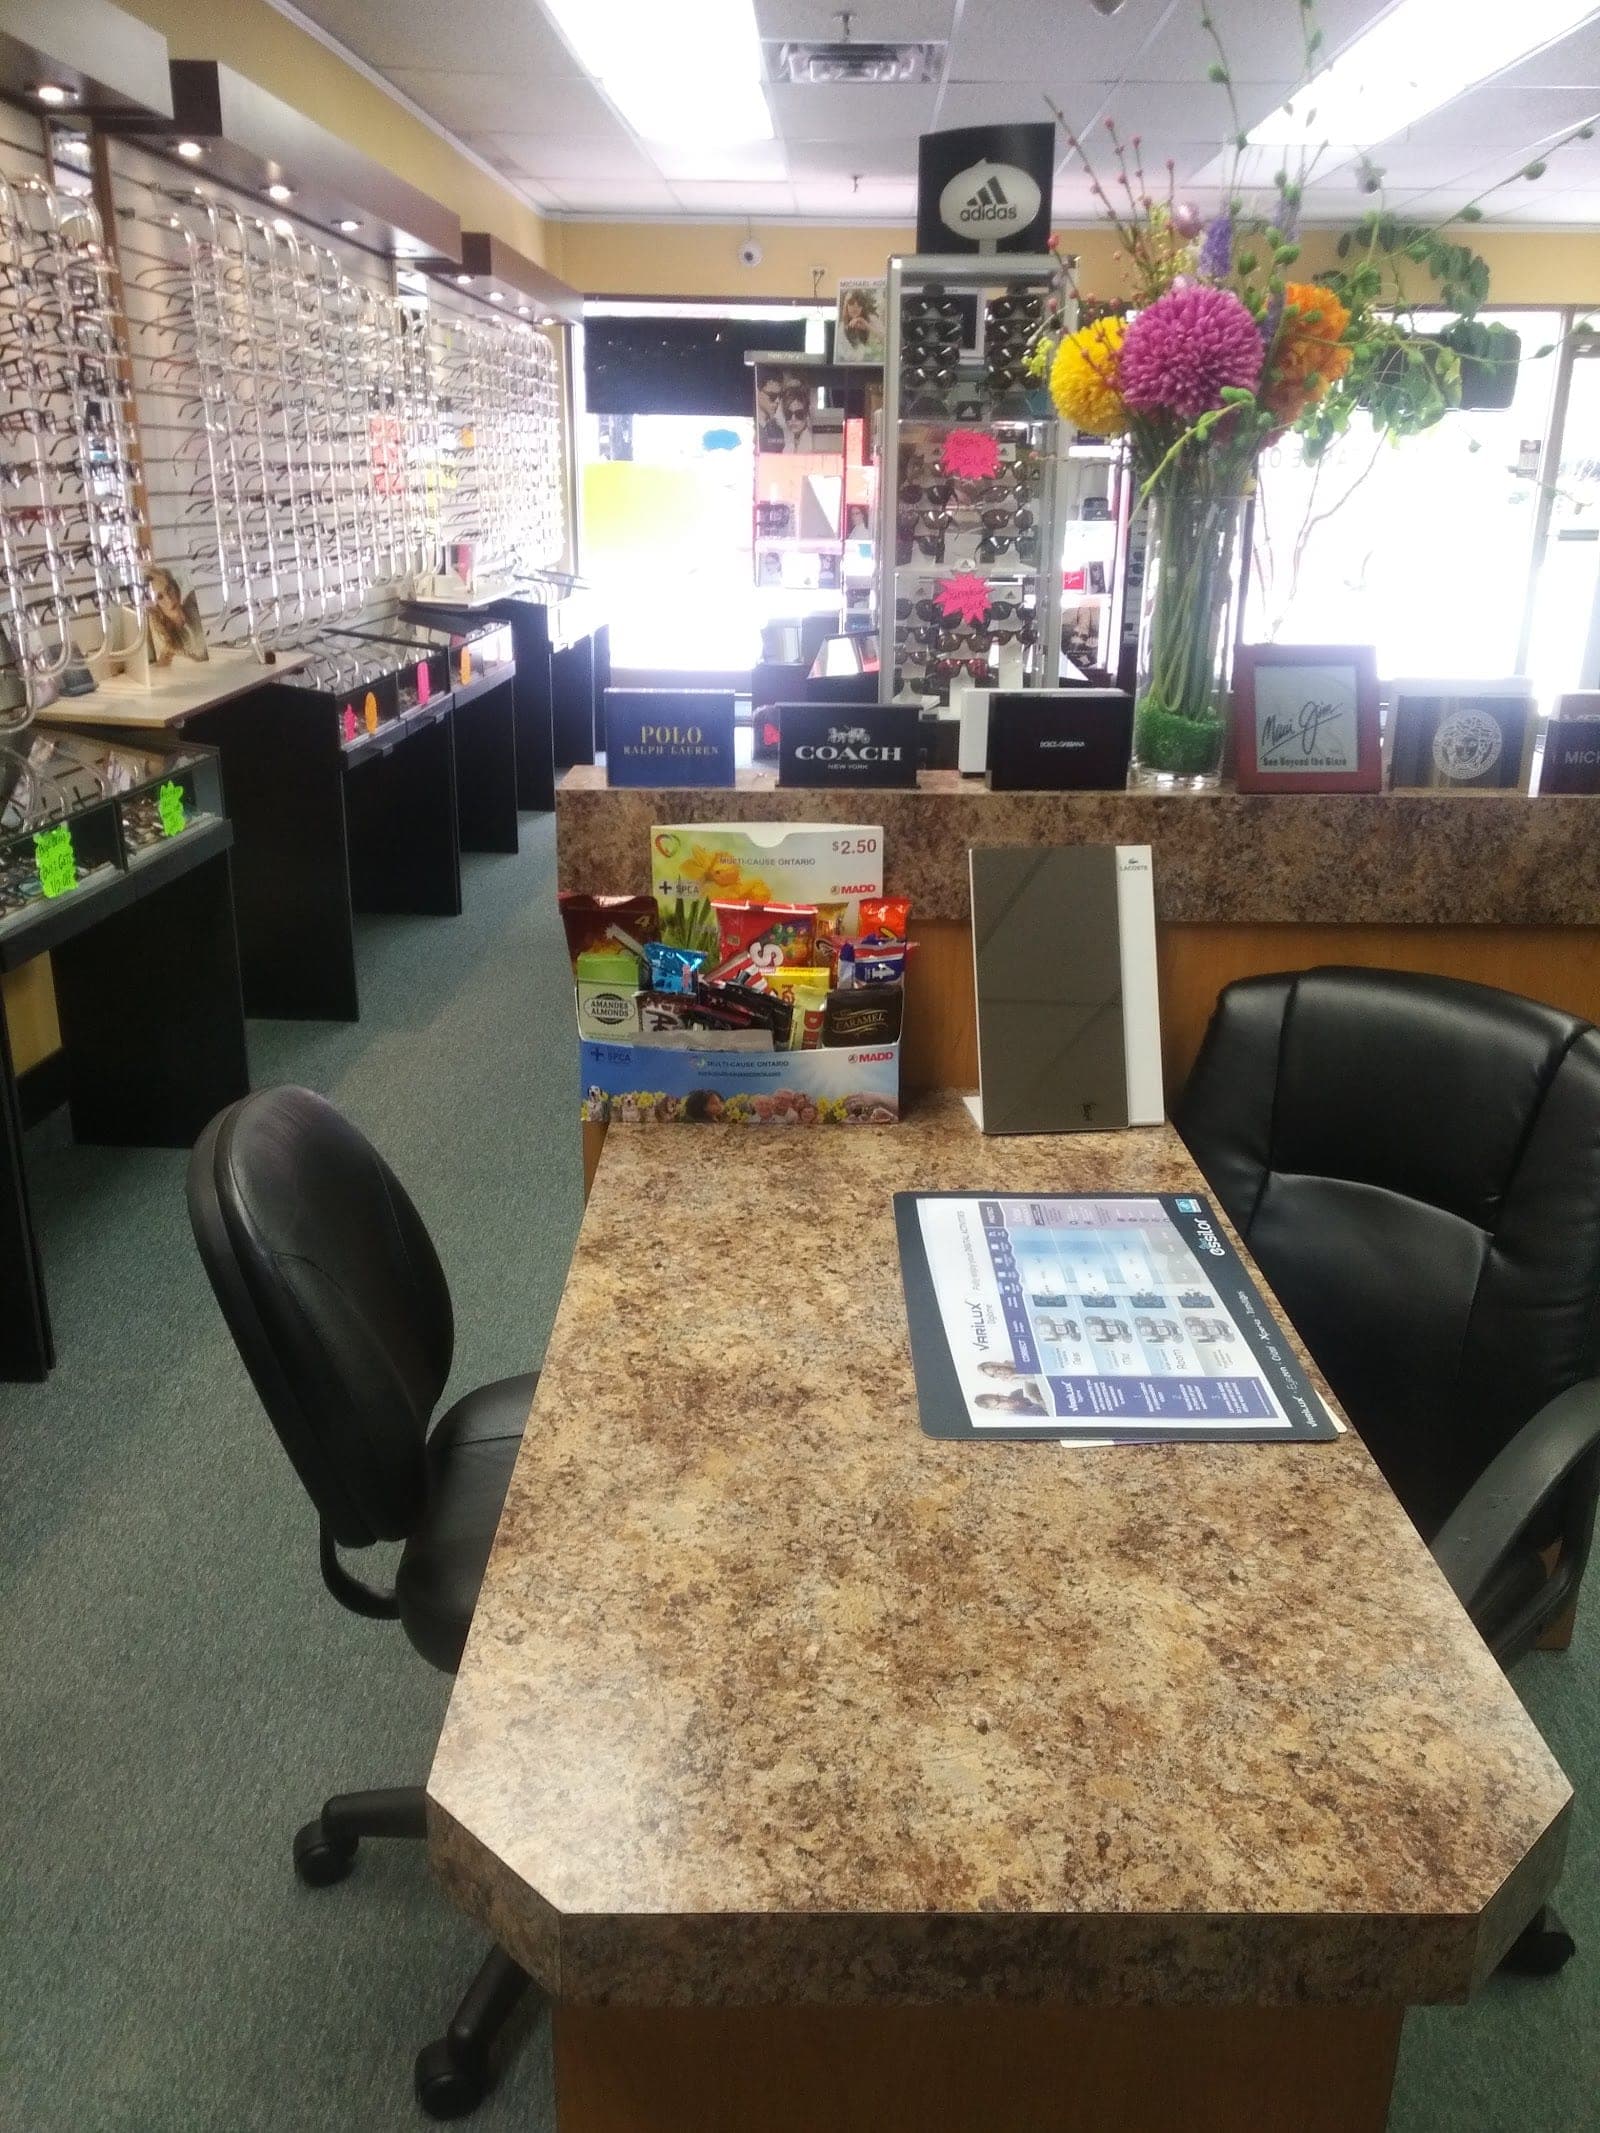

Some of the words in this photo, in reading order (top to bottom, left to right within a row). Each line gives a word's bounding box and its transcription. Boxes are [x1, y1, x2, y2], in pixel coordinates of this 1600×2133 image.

[960, 204, 1017, 222] adidas
[640, 725, 703, 745] POLO
[623, 745, 664, 755] RALPH
[671, 745, 719, 755] LAUREN
[795, 745, 901, 761] COACH
[1311, 757, 1324, 767] the
[832, 838, 877, 856] $2.50
[777, 857, 816, 866] ONTARIO
[840, 884, 876, 895] MADD
[590, 1001, 629, 1009] AMANDES
[591, 1008, 629, 1018] ALMONDS
[859, 1051, 894, 1063] MADD
[1194, 1218, 1226, 1257] essilor
